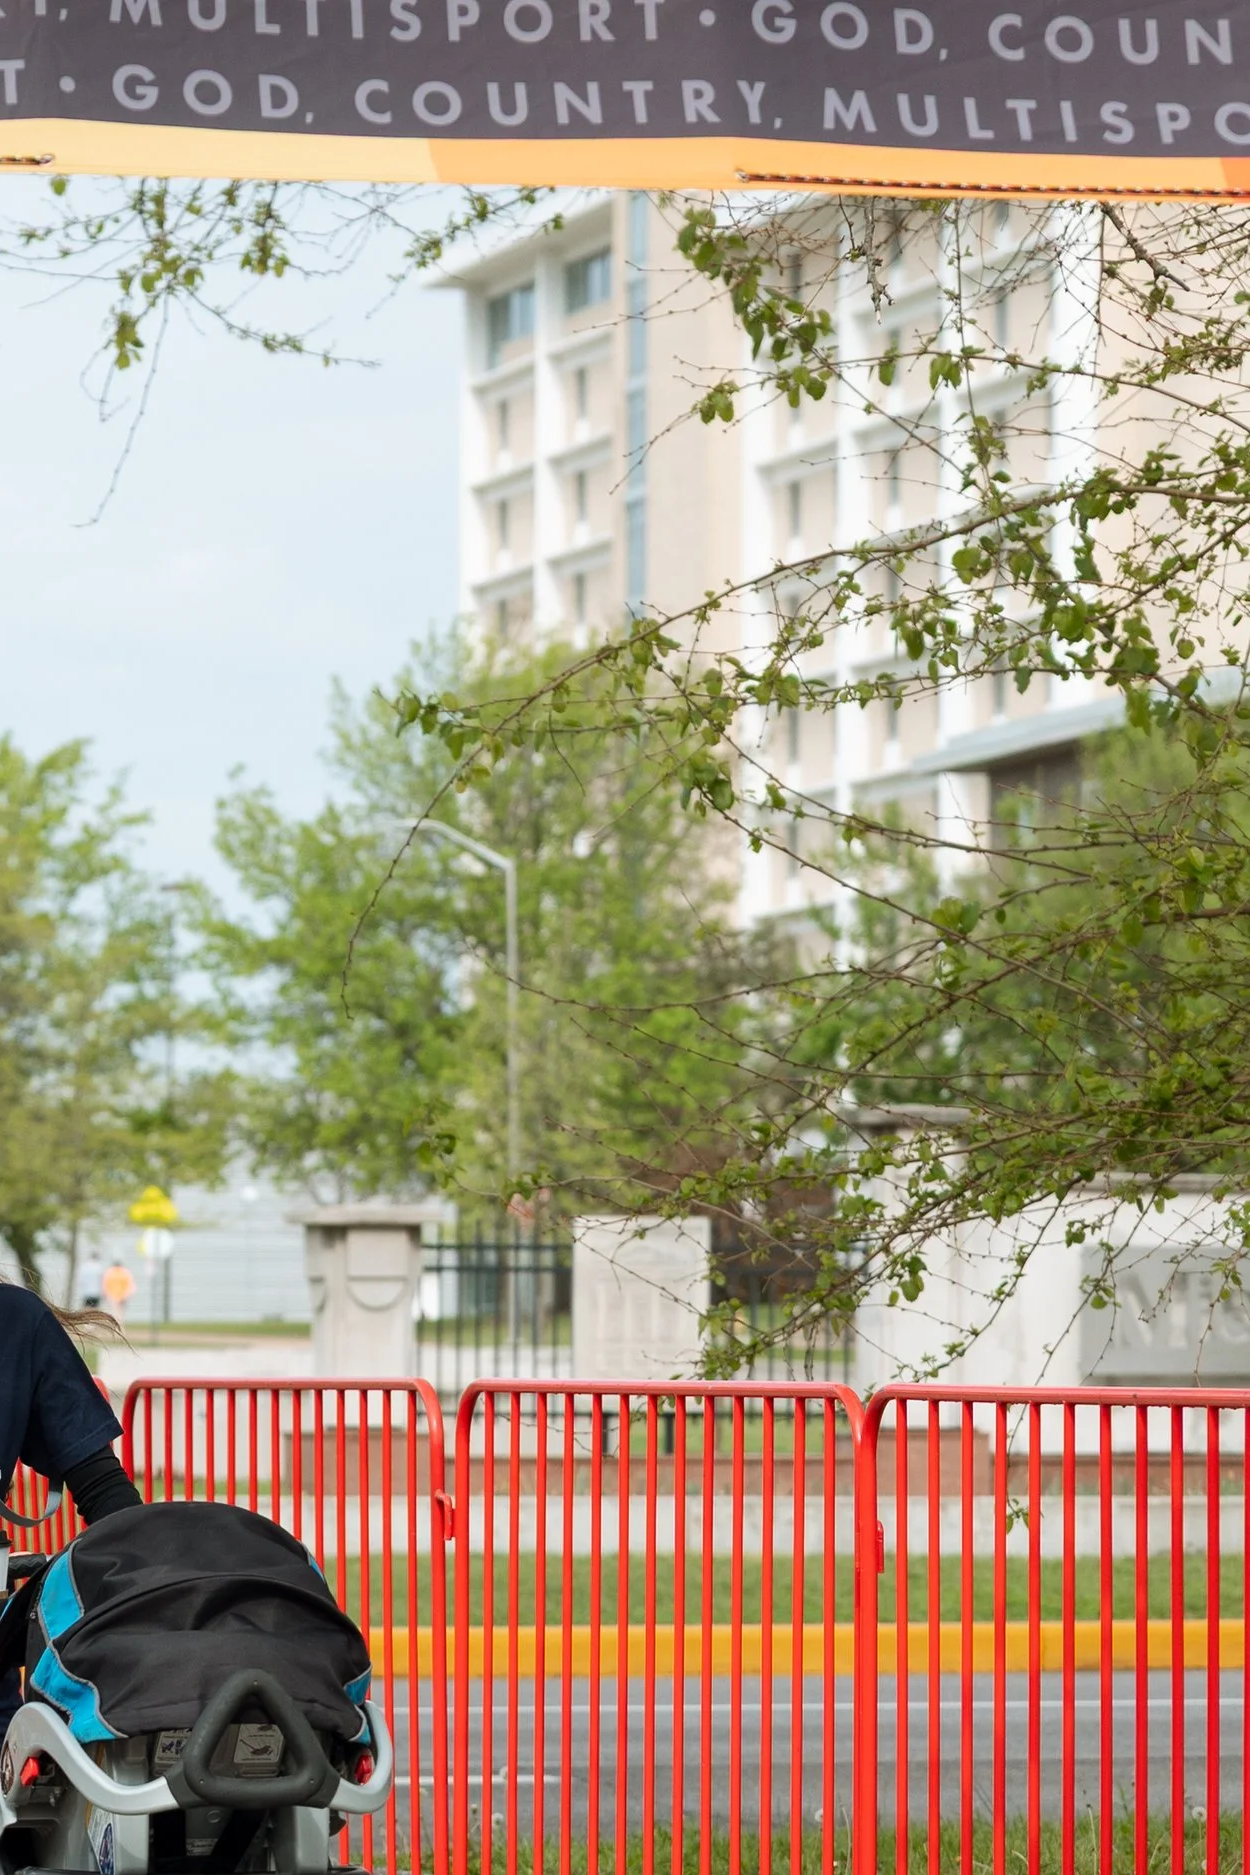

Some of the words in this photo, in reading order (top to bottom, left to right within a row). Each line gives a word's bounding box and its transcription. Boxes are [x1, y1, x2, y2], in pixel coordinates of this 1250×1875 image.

[109, 0, 665, 43] MULTISPORT
[751, 0, 947, 61] GOD,
[112, 64, 313, 124] GOD,
[354, 78, 783, 130] COUNTRY,
